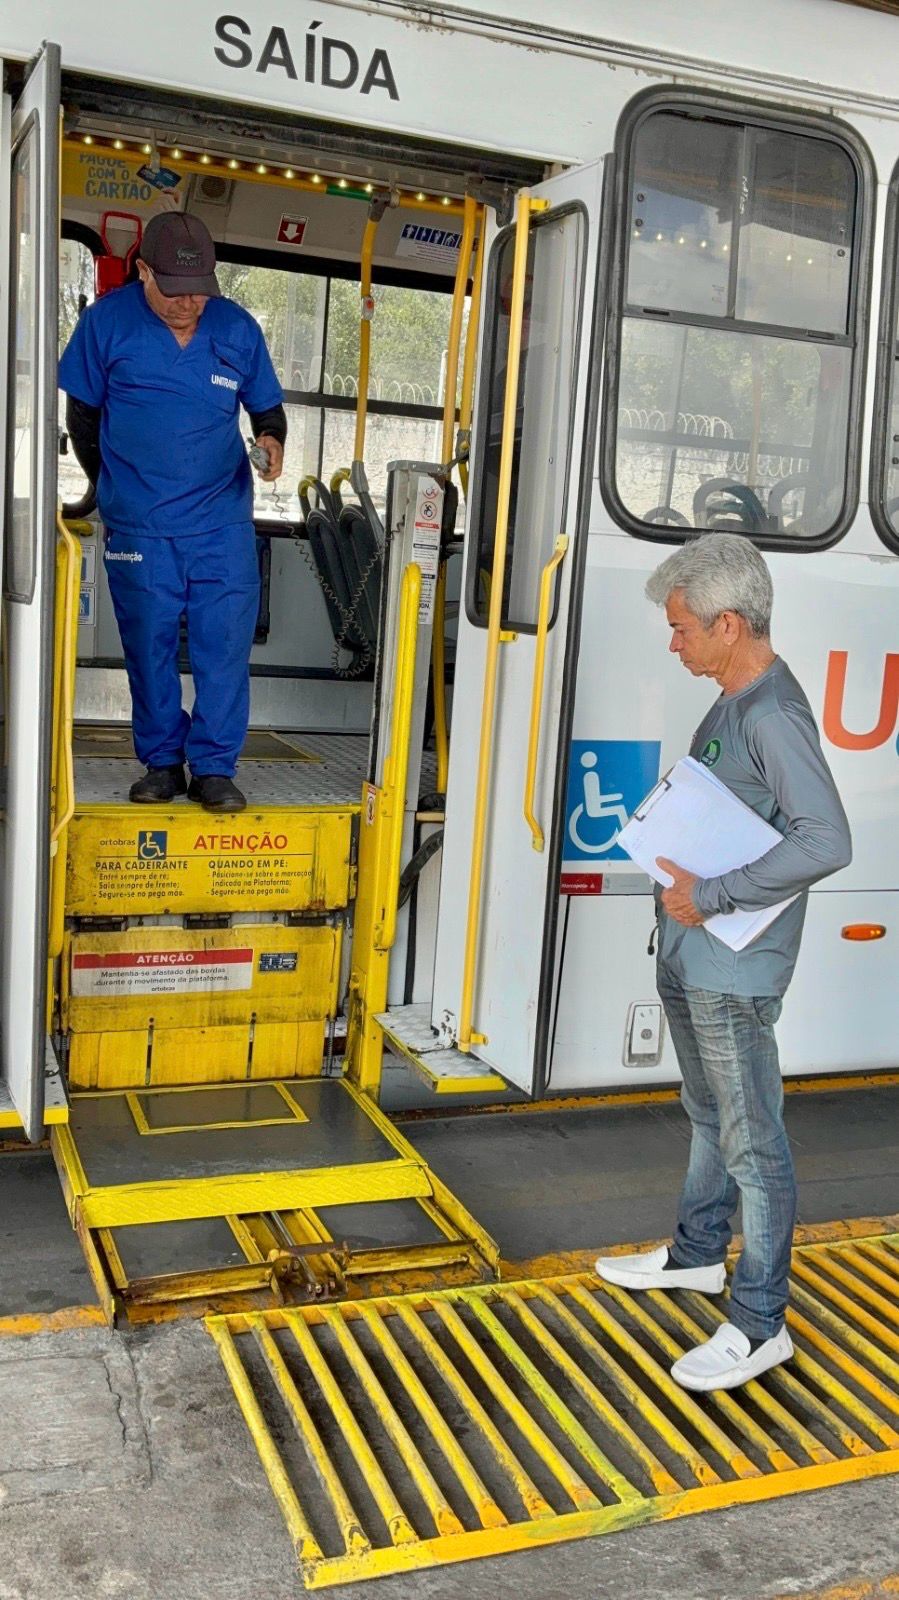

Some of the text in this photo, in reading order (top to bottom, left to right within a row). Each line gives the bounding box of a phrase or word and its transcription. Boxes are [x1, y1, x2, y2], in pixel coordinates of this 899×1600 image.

[213, 15, 400, 101] SAÍDA
[88, 166, 129, 180] COM O
[85, 180, 152, 200] CARTÃO
[100, 837, 136, 846] ortobras
[193, 831, 288, 852] ATENÇÃO
[95, 860, 188, 871] PARA CADEIRANTE
[208, 859, 254, 869] QUANDO
[257, 859, 270, 868] EM
[145, 881, 154, 889] de
[136, 953, 194, 964] ATENÇÃO
